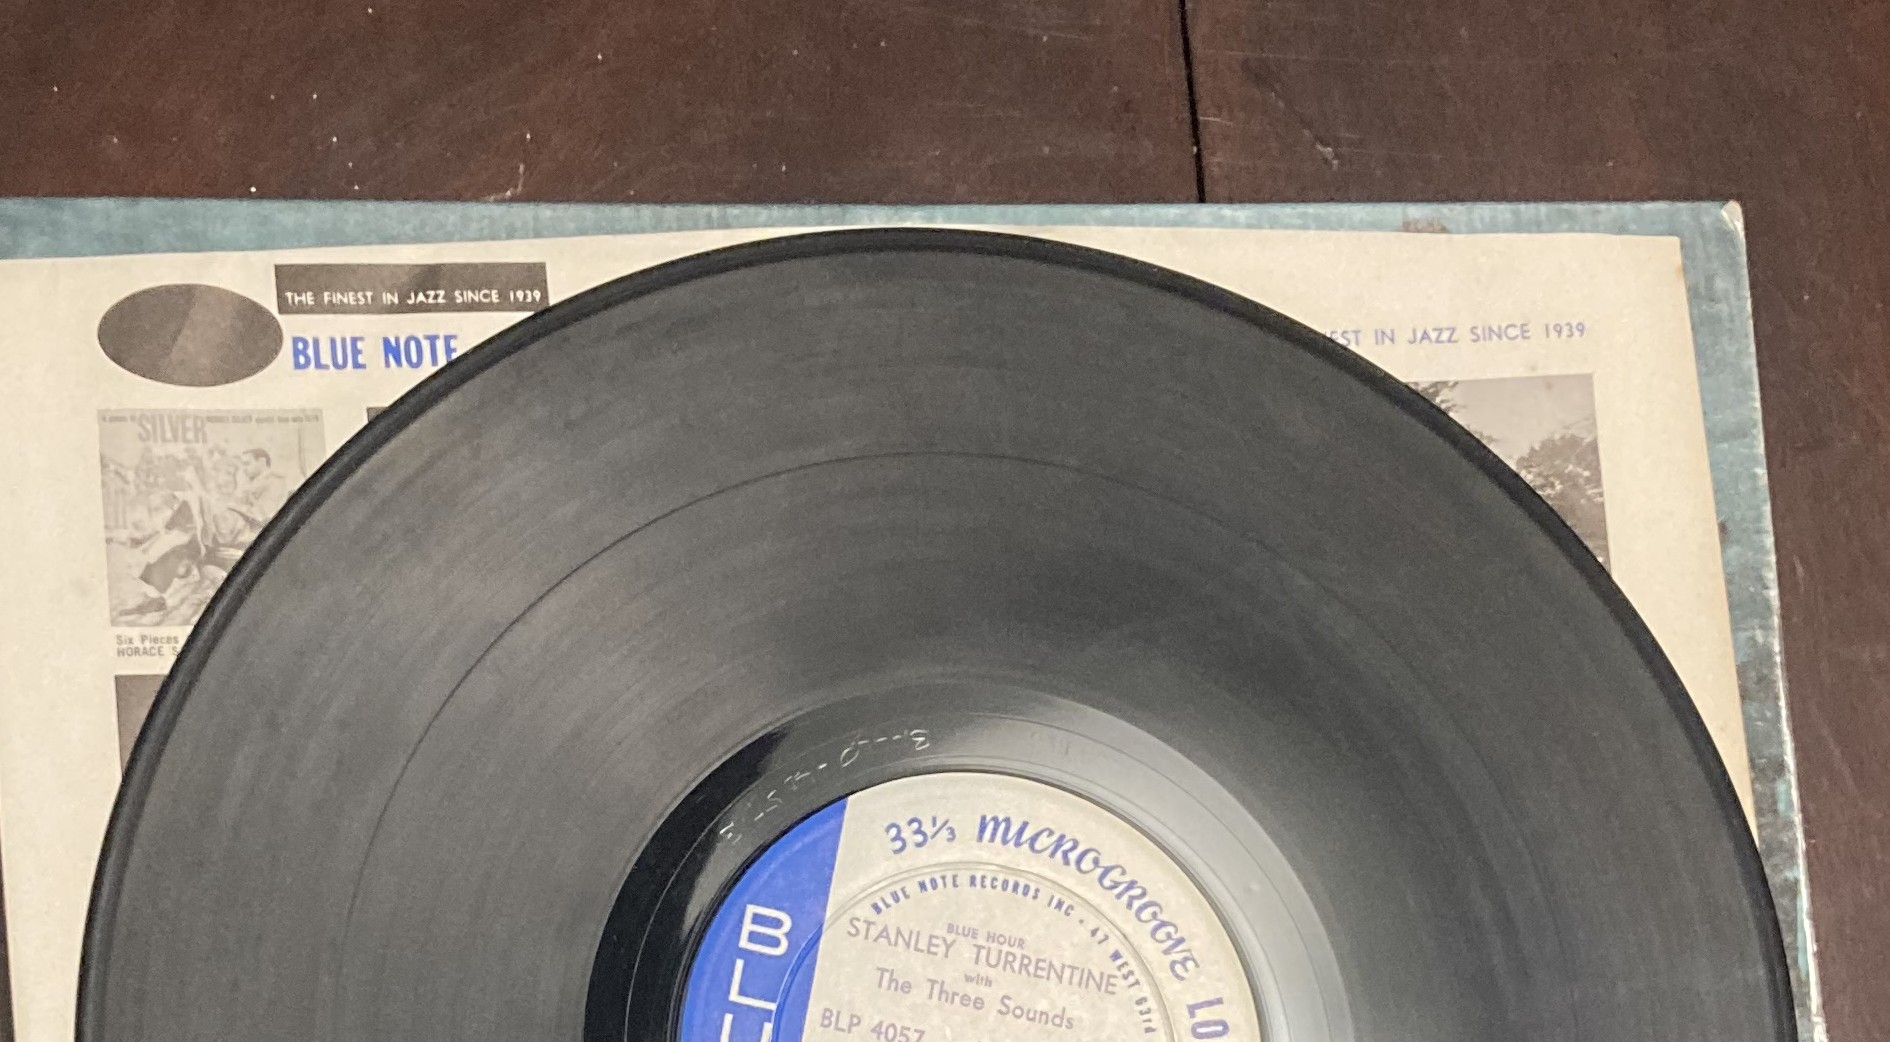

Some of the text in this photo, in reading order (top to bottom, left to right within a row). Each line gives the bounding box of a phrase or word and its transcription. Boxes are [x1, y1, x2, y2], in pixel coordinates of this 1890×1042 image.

[285, 289, 542, 306] THE FINEST IN JAZZ SINCE 1939
[1374, 328, 1395, 345] IN
[1407, 326, 1459, 344] JAZZ
[1470, 323, 1532, 344] SINCE
[1543, 321, 1587, 340] 1939
[291, 334, 459, 370] BLUE NOTE
[138, 414, 207, 443] SILVER
[115, 634, 180, 646] Six Pieces
[117, 646, 165, 657] HORACE
[870, 886, 911, 915] BLUE
[917, 874, 960, 893] NOTE
[969, 875, 1040, 901] RECORDS
[1047, 894, 1075, 917] INC
[1089, 927, 1110, 945] 47
[1109, 949, 1141, 990] WEST
[946, 922, 1026, 950] BLUE HOUR
[847, 917, 1119, 996] STANLEY TURRENTINE
[964, 972, 993, 988] with
[876, 967, 1075, 1030] The Three Sounds
[820, 1007, 862, 1036] BLP
